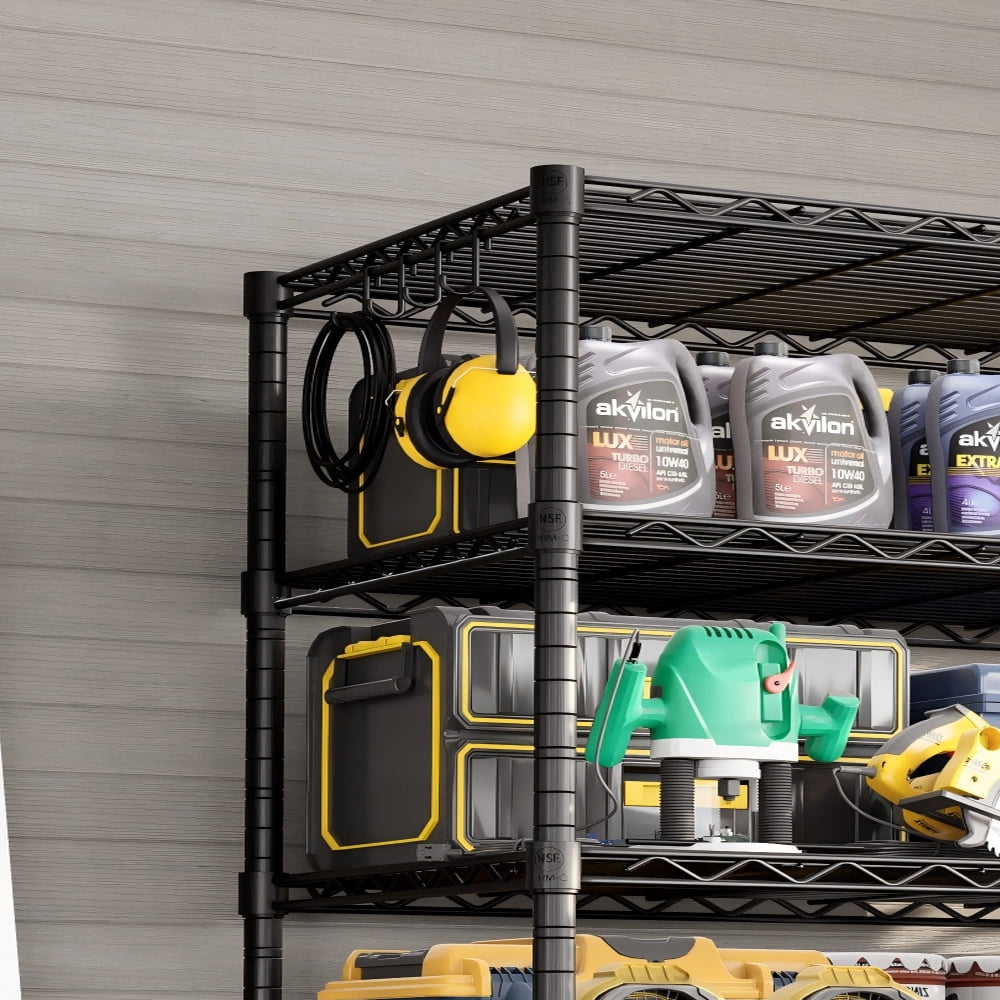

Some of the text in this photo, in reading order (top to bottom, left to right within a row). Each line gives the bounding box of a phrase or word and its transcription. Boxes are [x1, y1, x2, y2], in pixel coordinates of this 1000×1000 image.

[596, 398, 679, 422] akvilon
[770, 413, 855, 436] akvilon
[593, 431, 633, 449] LUX
[656, 437, 680, 446] motor
[612, 452, 649, 464] TURBO
[768, 445, 809, 462] LUX
[831, 450, 864, 460] motor oil
[619, 462, 648, 472] DIESEL
[656, 455, 689, 469] 10W40
[786, 466, 824, 476] TURBO
[831, 468, 865, 481] 10W40
[793, 475, 823, 484] DIESEL
[540, 513, 562, 524] NSF
[535, 853, 559, 864] NSF
